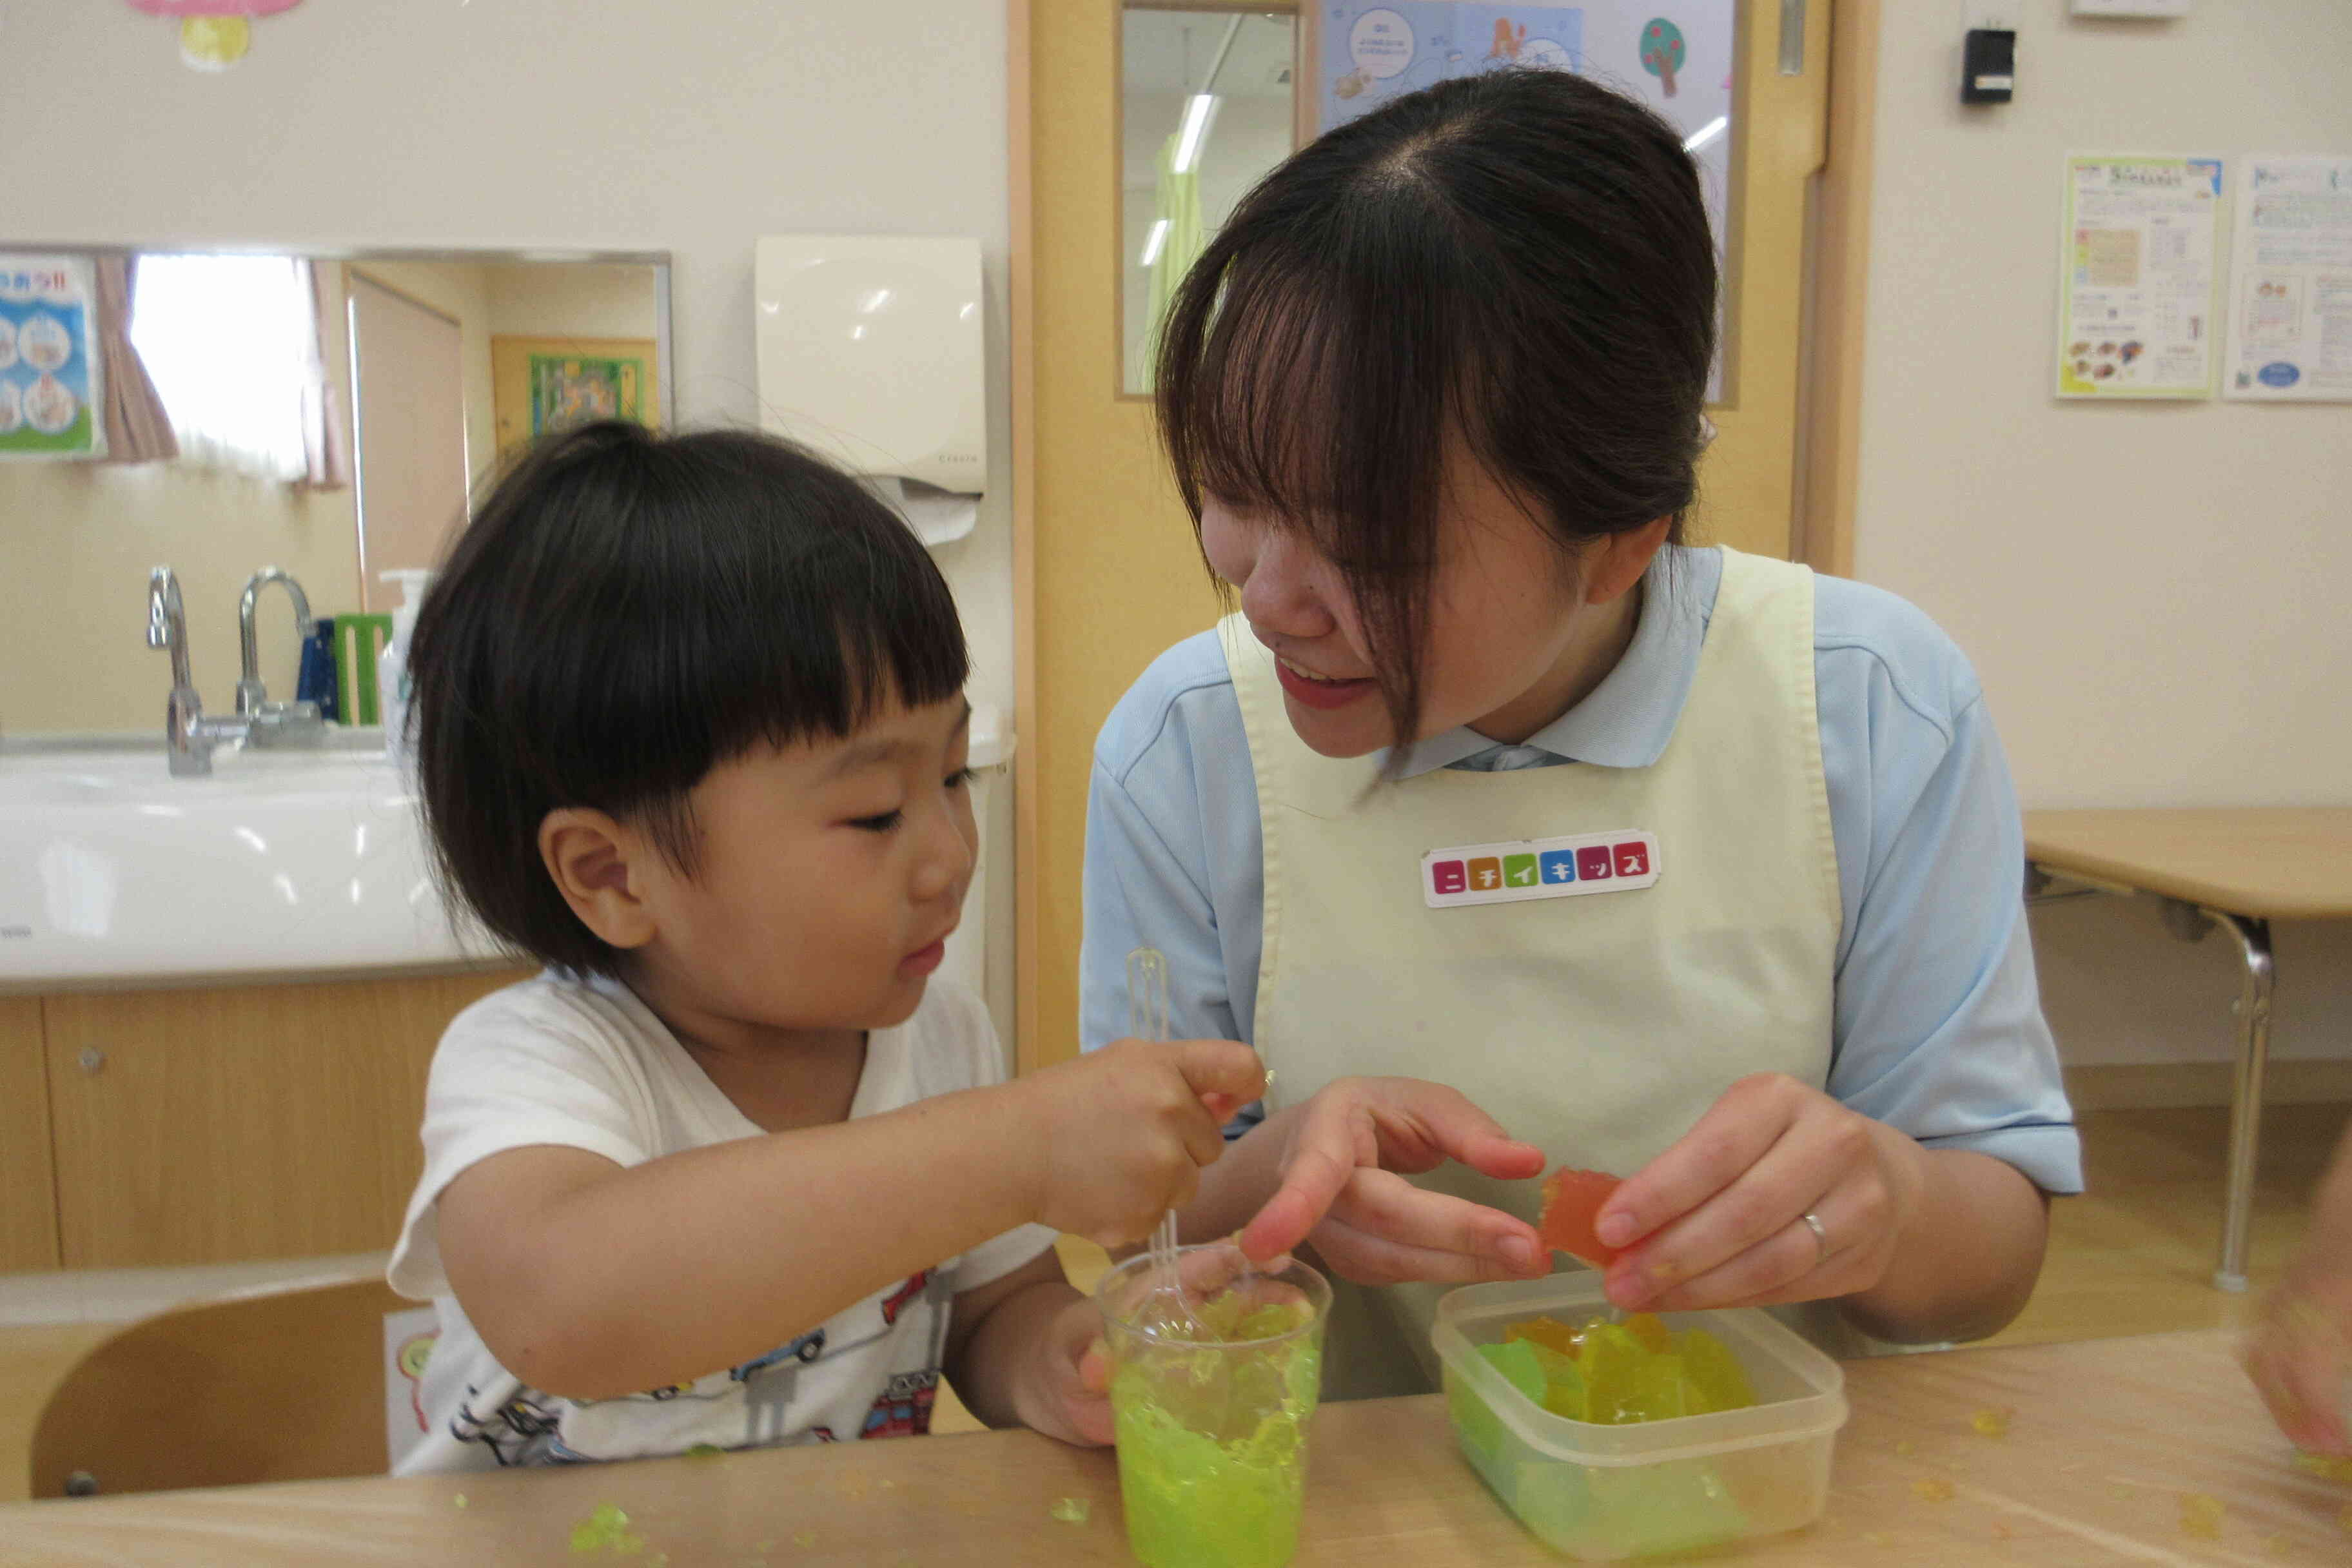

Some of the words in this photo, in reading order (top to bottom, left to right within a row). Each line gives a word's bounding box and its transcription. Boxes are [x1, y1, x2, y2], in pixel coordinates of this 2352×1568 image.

[1444, 852, 1647, 891] ニチイキッズ
